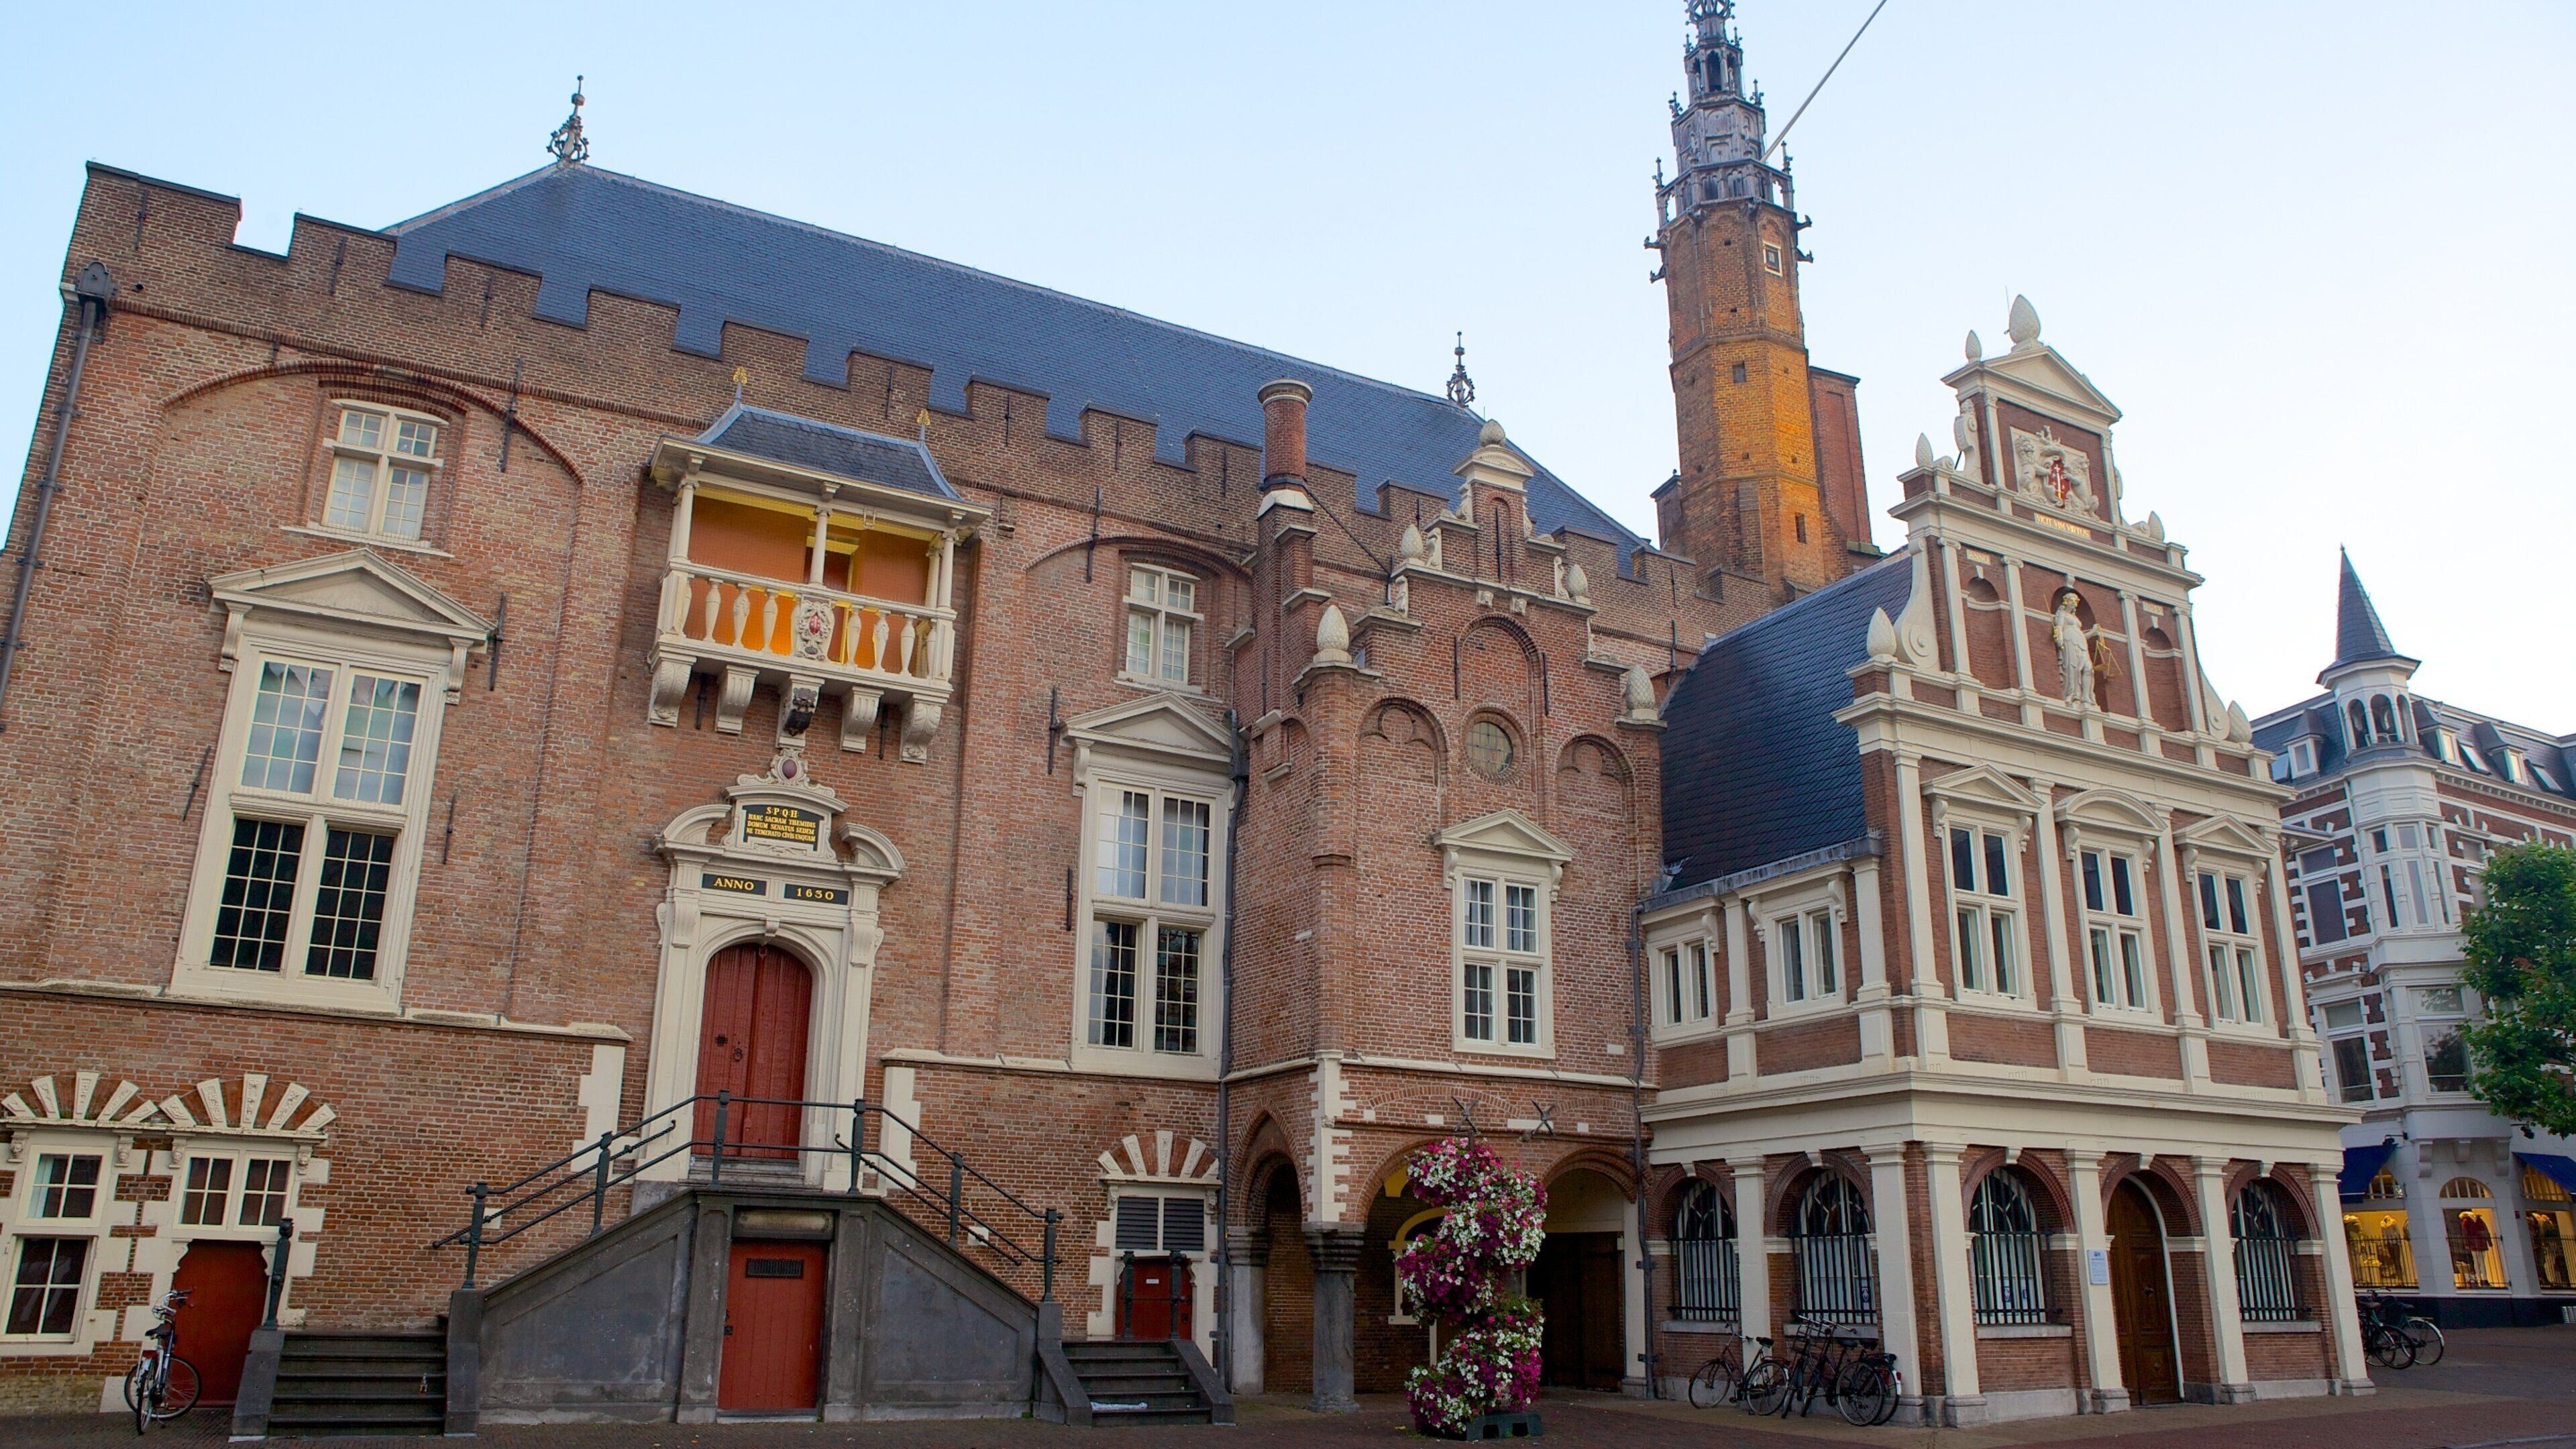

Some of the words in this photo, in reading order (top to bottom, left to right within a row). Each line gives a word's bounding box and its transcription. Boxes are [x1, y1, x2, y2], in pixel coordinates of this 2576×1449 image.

[747, 820, 768, 829] DOMUM
[770, 824, 794, 833] SENATUS
[796, 826, 814, 835] SEDEM
[789, 819, 816, 828] THEMIDIS
[755, 828, 781, 837] TEMERATO
[713, 877, 755, 890] ANNO
[796, 888, 834, 900] 1630
